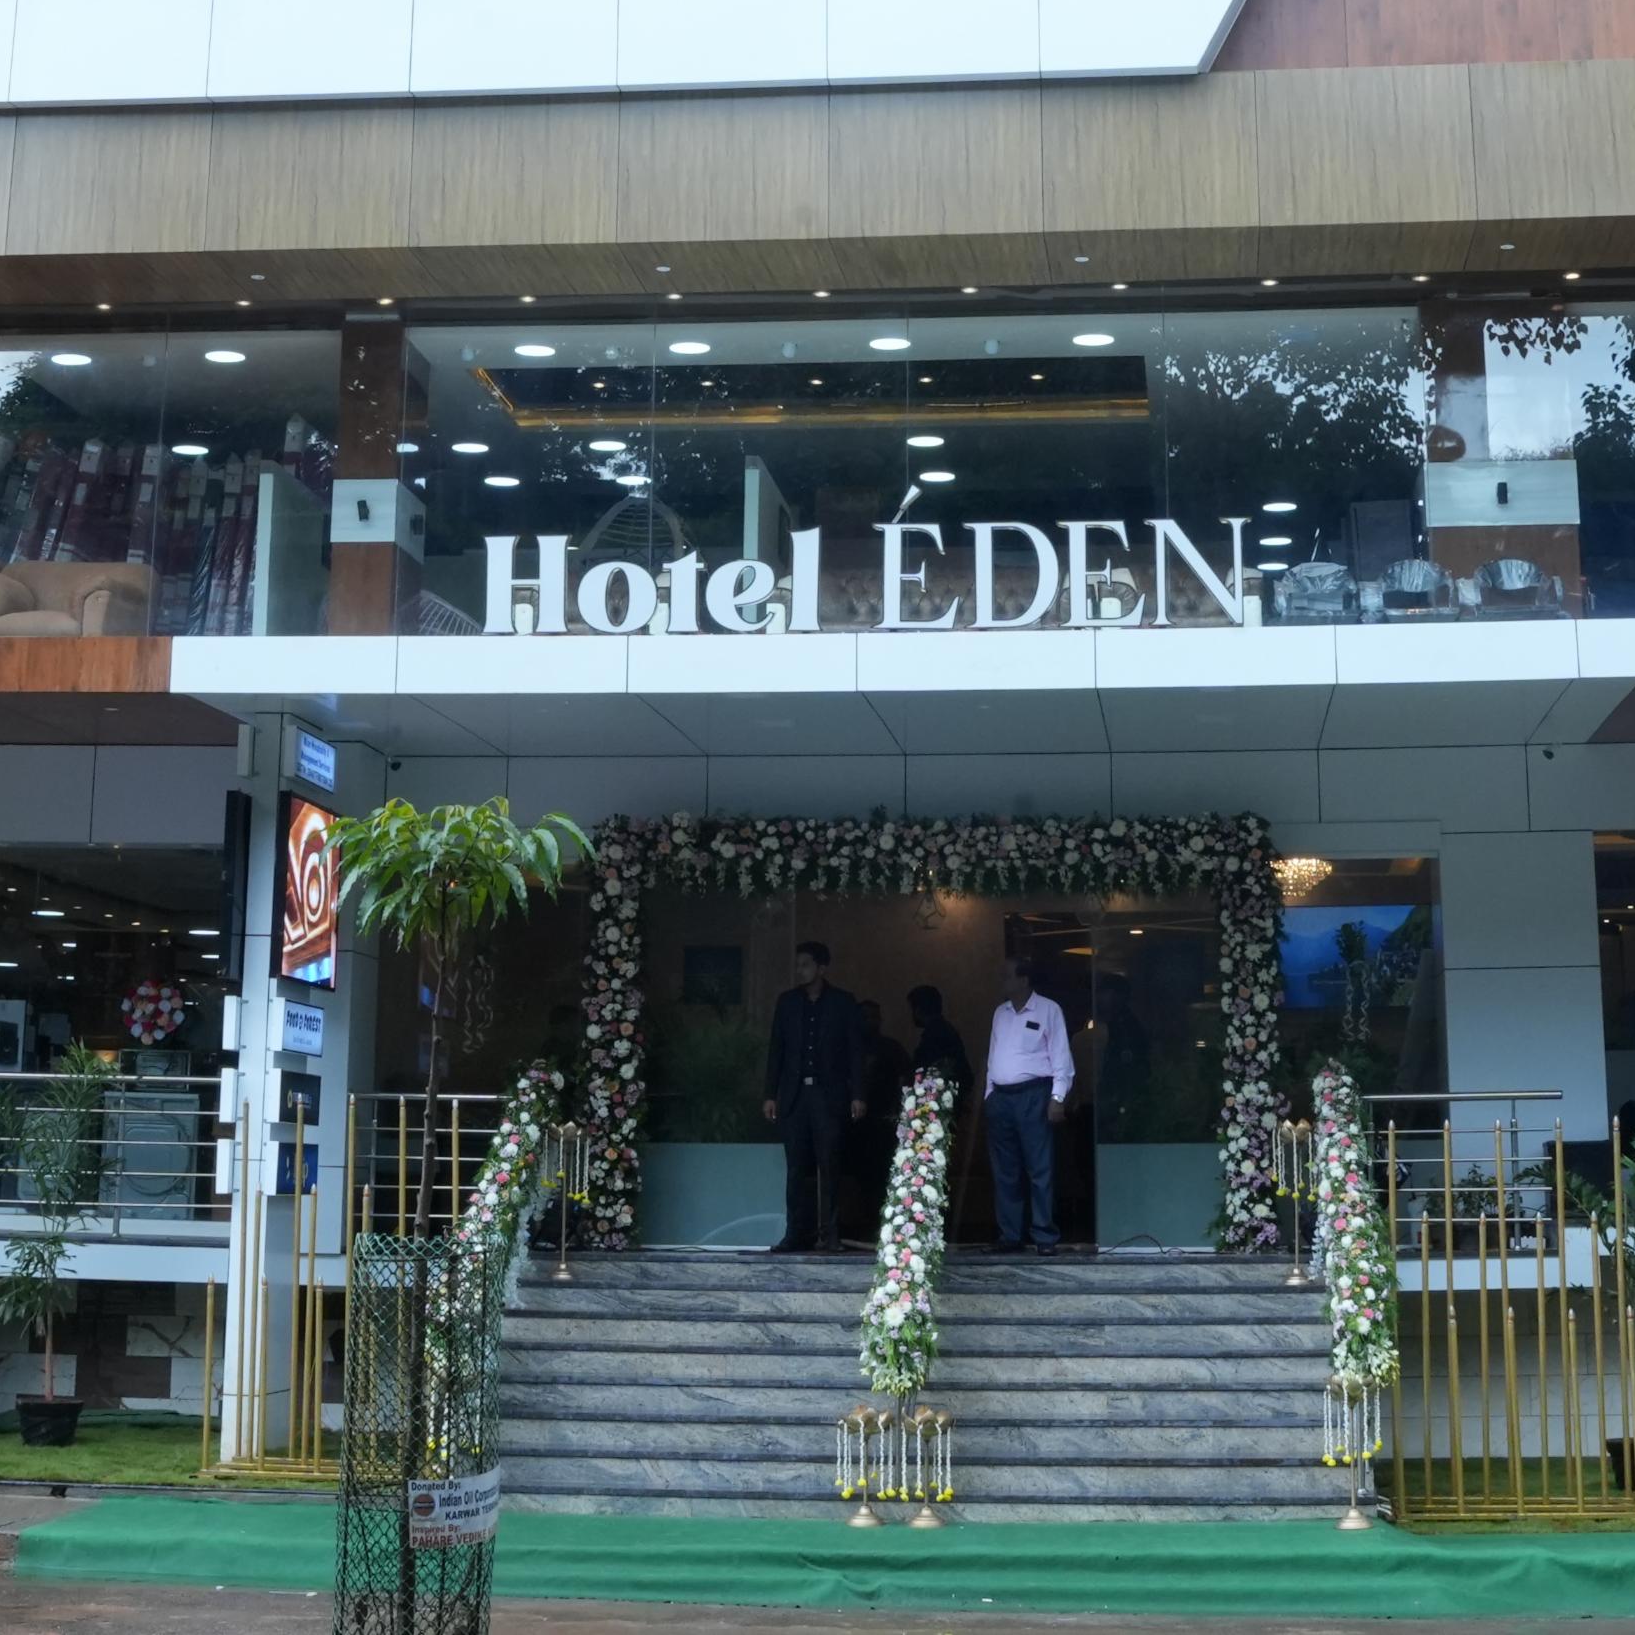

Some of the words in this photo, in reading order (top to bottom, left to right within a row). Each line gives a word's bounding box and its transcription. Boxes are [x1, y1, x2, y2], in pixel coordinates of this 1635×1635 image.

[482, 527, 822, 635] Hotel
[872, 484, 1251, 631] ÉDEN
[411, 1481, 445, 1491] Donated
[448, 1480, 461, 1491] By:
[439, 1493, 462, 1507] Indian
[464, 1491, 473, 1505] Oil
[445, 1507, 480, 1521] KARWAR
[412, 1525, 445, 1535] Inspired
[448, 1523, 461, 1533] By:
[412, 1535, 453, 1547] PAHARE
